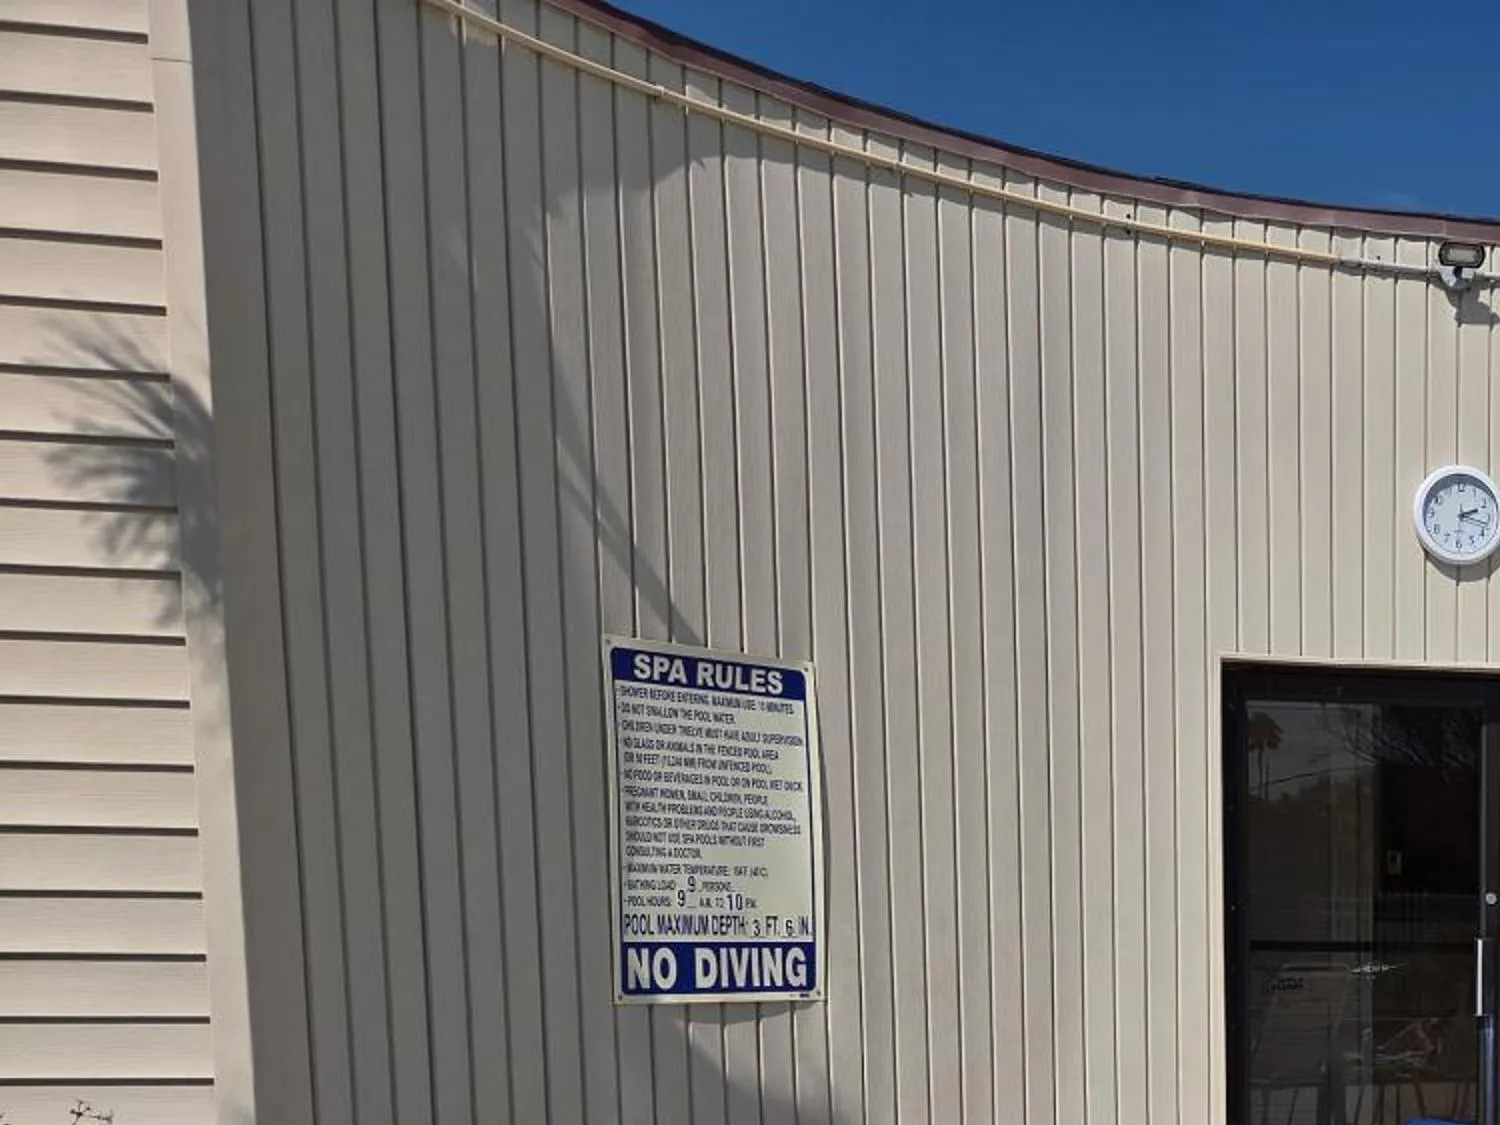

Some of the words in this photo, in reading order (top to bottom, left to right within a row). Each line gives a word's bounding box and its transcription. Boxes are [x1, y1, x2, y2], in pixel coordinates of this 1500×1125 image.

[634, 654, 687, 684] SPA
[697, 662, 784, 695] RULES
[687, 876, 696, 892] 9
[677, 889, 685, 906] 9
[726, 893, 743, 910] 10
[624, 914, 653, 934] POOL
[657, 915, 708, 935] MAXIMUM
[752, 919, 760, 936] 3
[785, 919, 793, 936] 6
[627, 947, 677, 990] NO
[696, 946, 807, 988] DIVING
